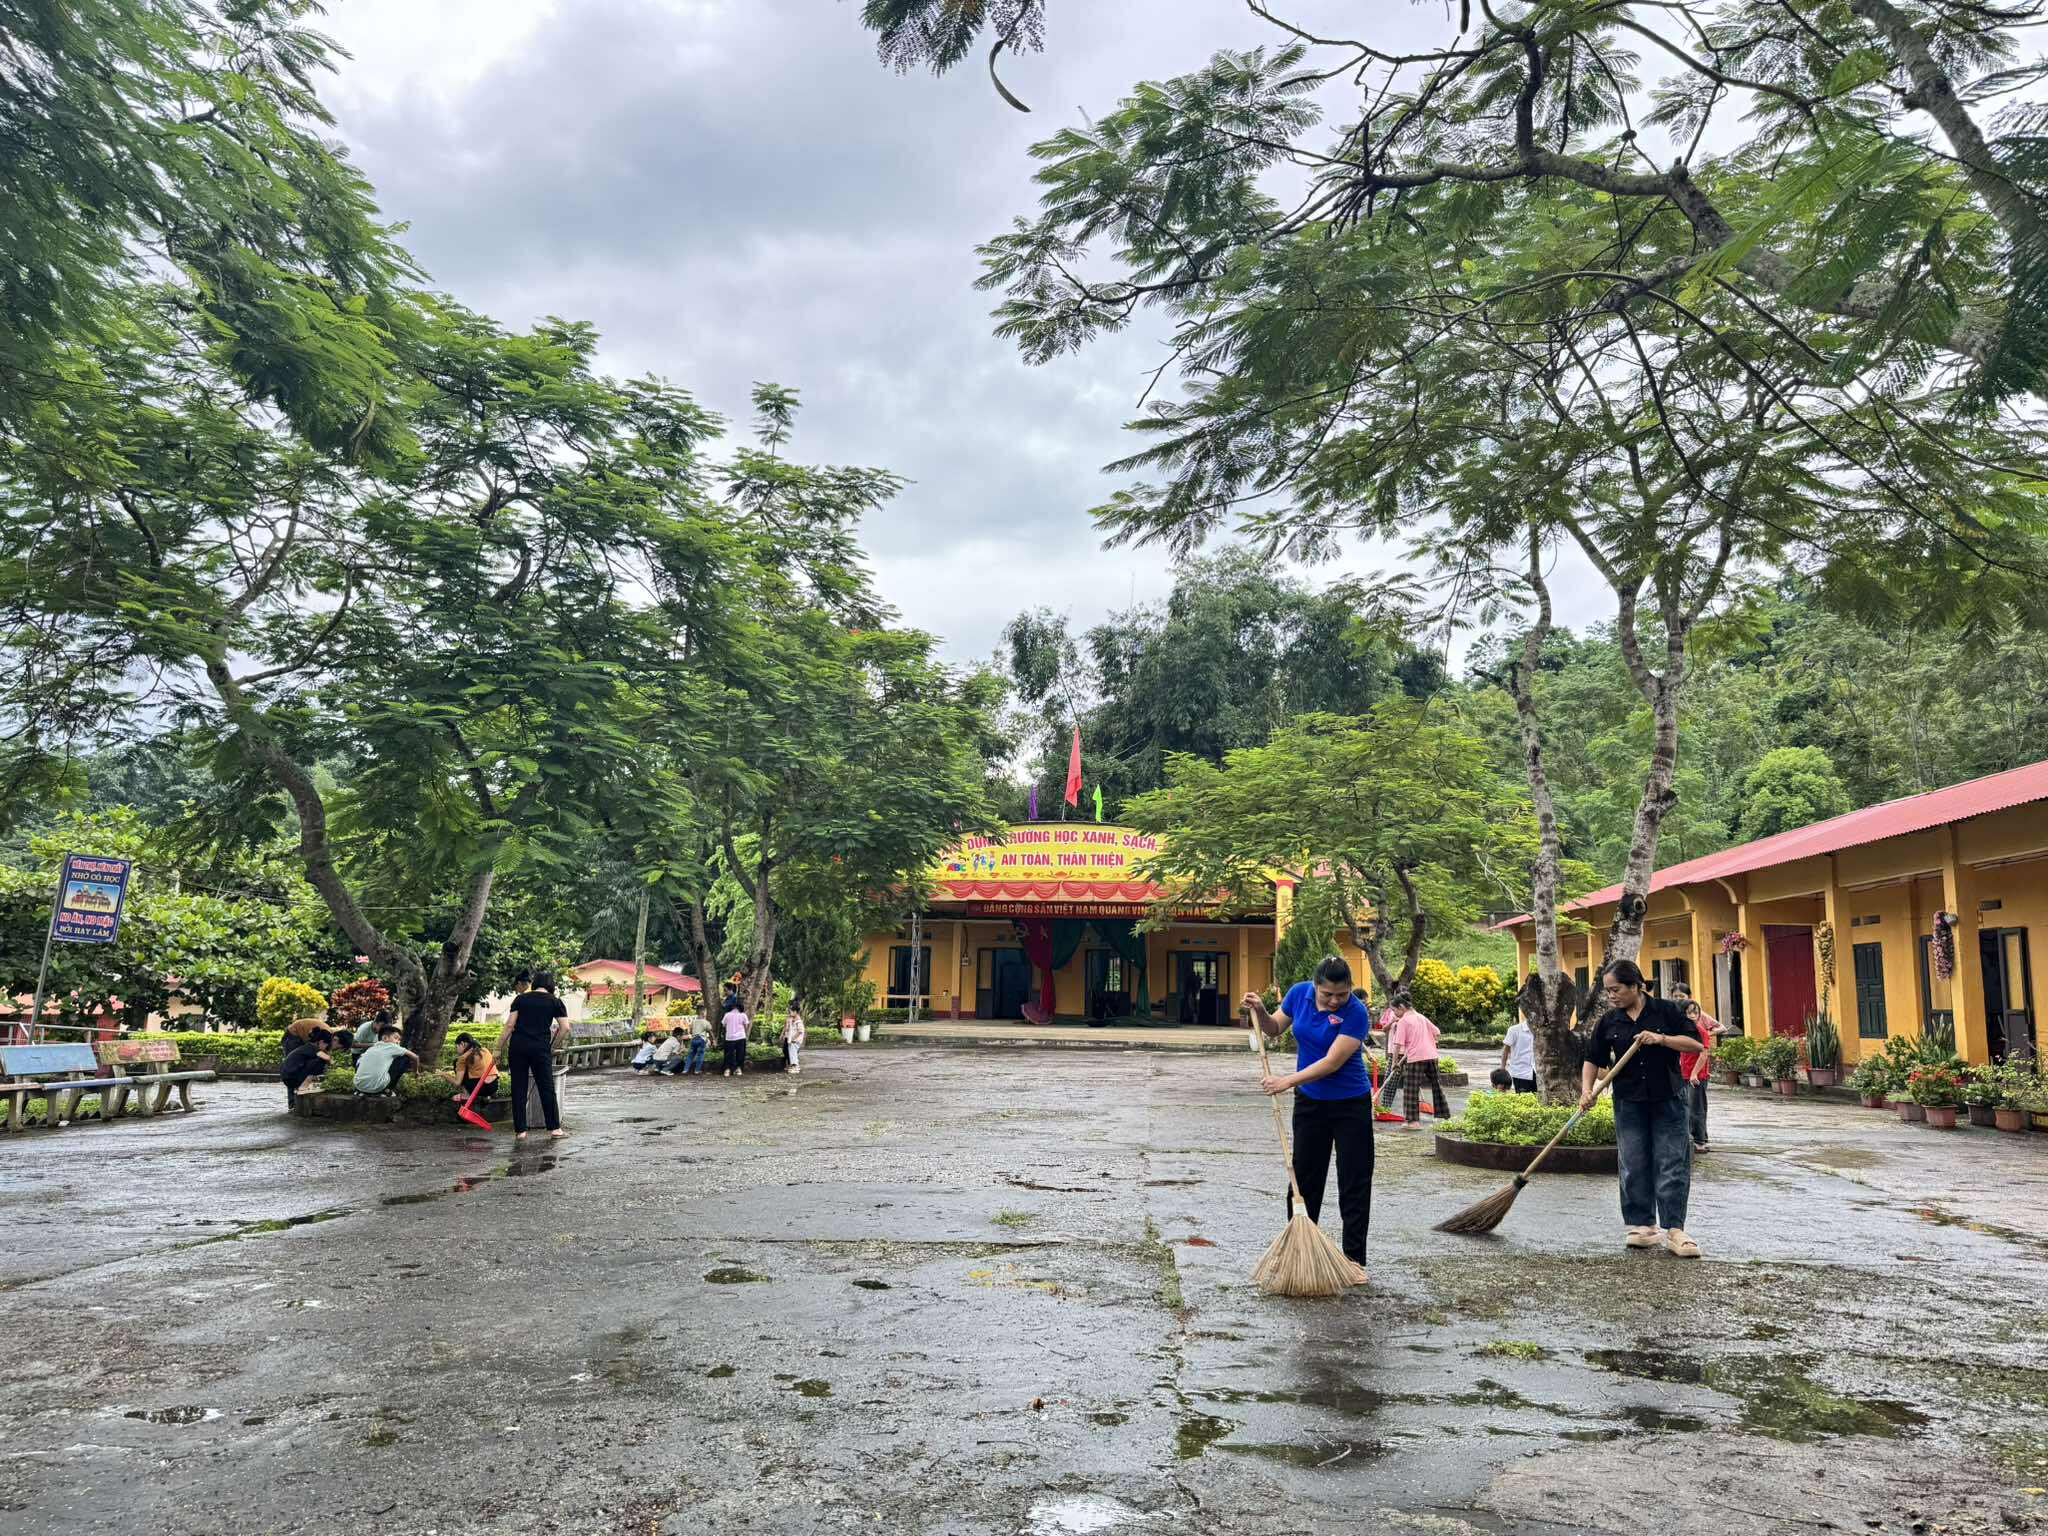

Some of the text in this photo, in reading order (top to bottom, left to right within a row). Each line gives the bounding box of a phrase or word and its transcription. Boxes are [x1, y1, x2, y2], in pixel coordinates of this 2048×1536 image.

[1055, 830, 1078, 844] HỌC
[1083, 831, 1118, 846] XANH,
[1122, 834, 1157, 851] SẠCH,
[1001, 851, 1124, 868] AN TOÀN, THÂN THIỆN
[947, 863, 967, 872] ABC
[1054, 903, 1073, 914] VIỆT
[1075, 905, 1098, 914] NAM
[1099, 904, 1131, 915] QUANG
[74, 927, 91, 935] HAY
[92, 928, 110, 936] LÀM
